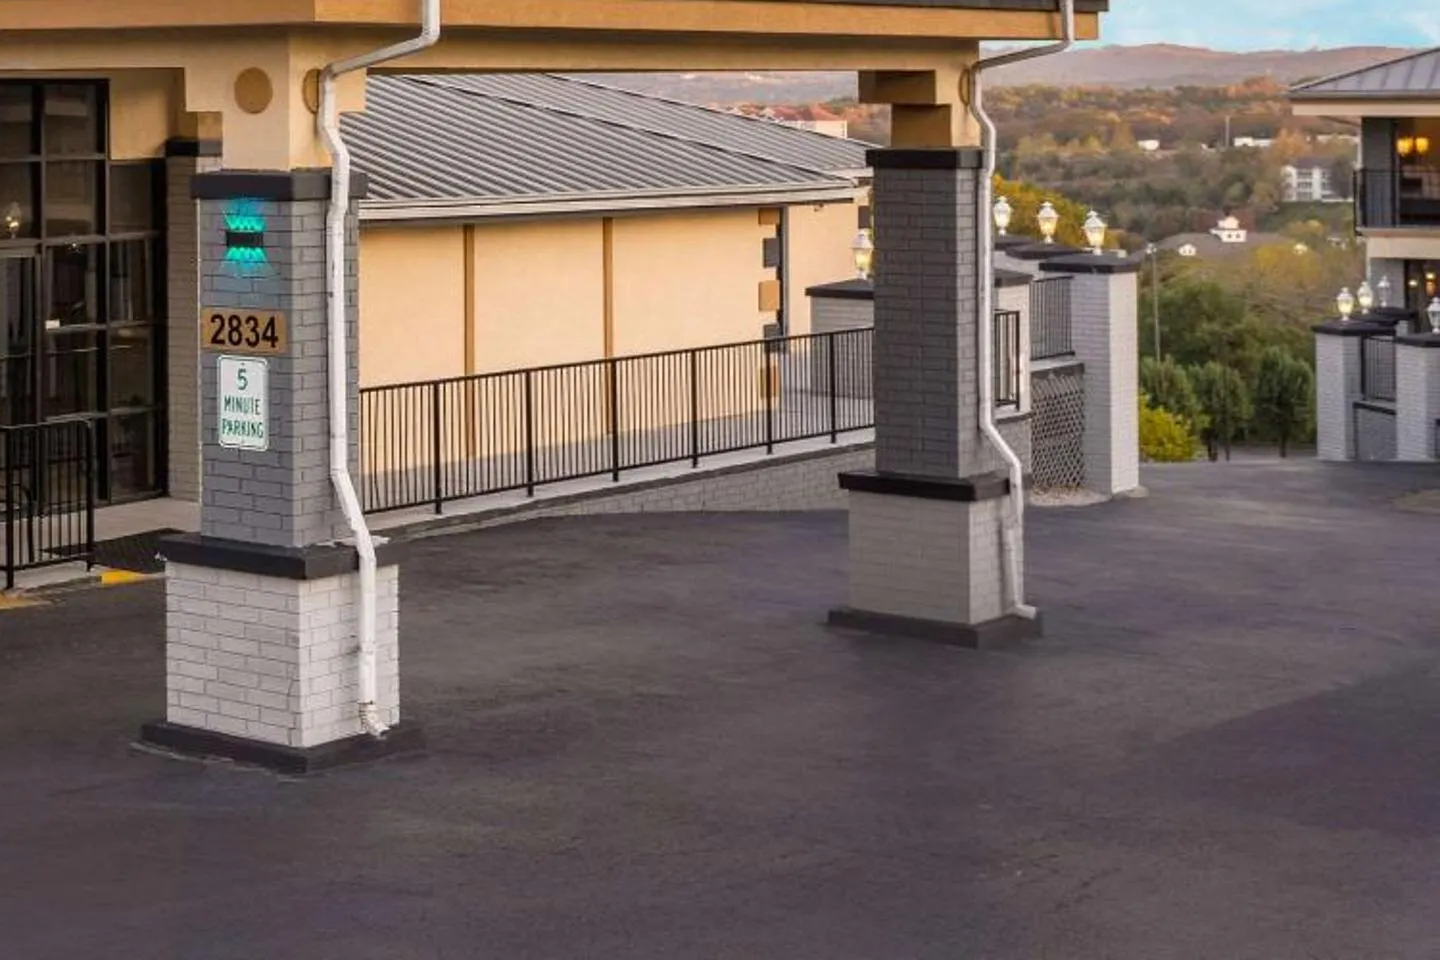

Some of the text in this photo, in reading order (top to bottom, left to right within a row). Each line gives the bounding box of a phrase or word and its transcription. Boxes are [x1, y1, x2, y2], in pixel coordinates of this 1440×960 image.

[210, 314, 279, 348] 2834
[237, 368, 248, 390] 5
[224, 395, 261, 416] MINUTE
[222, 418, 264, 439] PARKING
